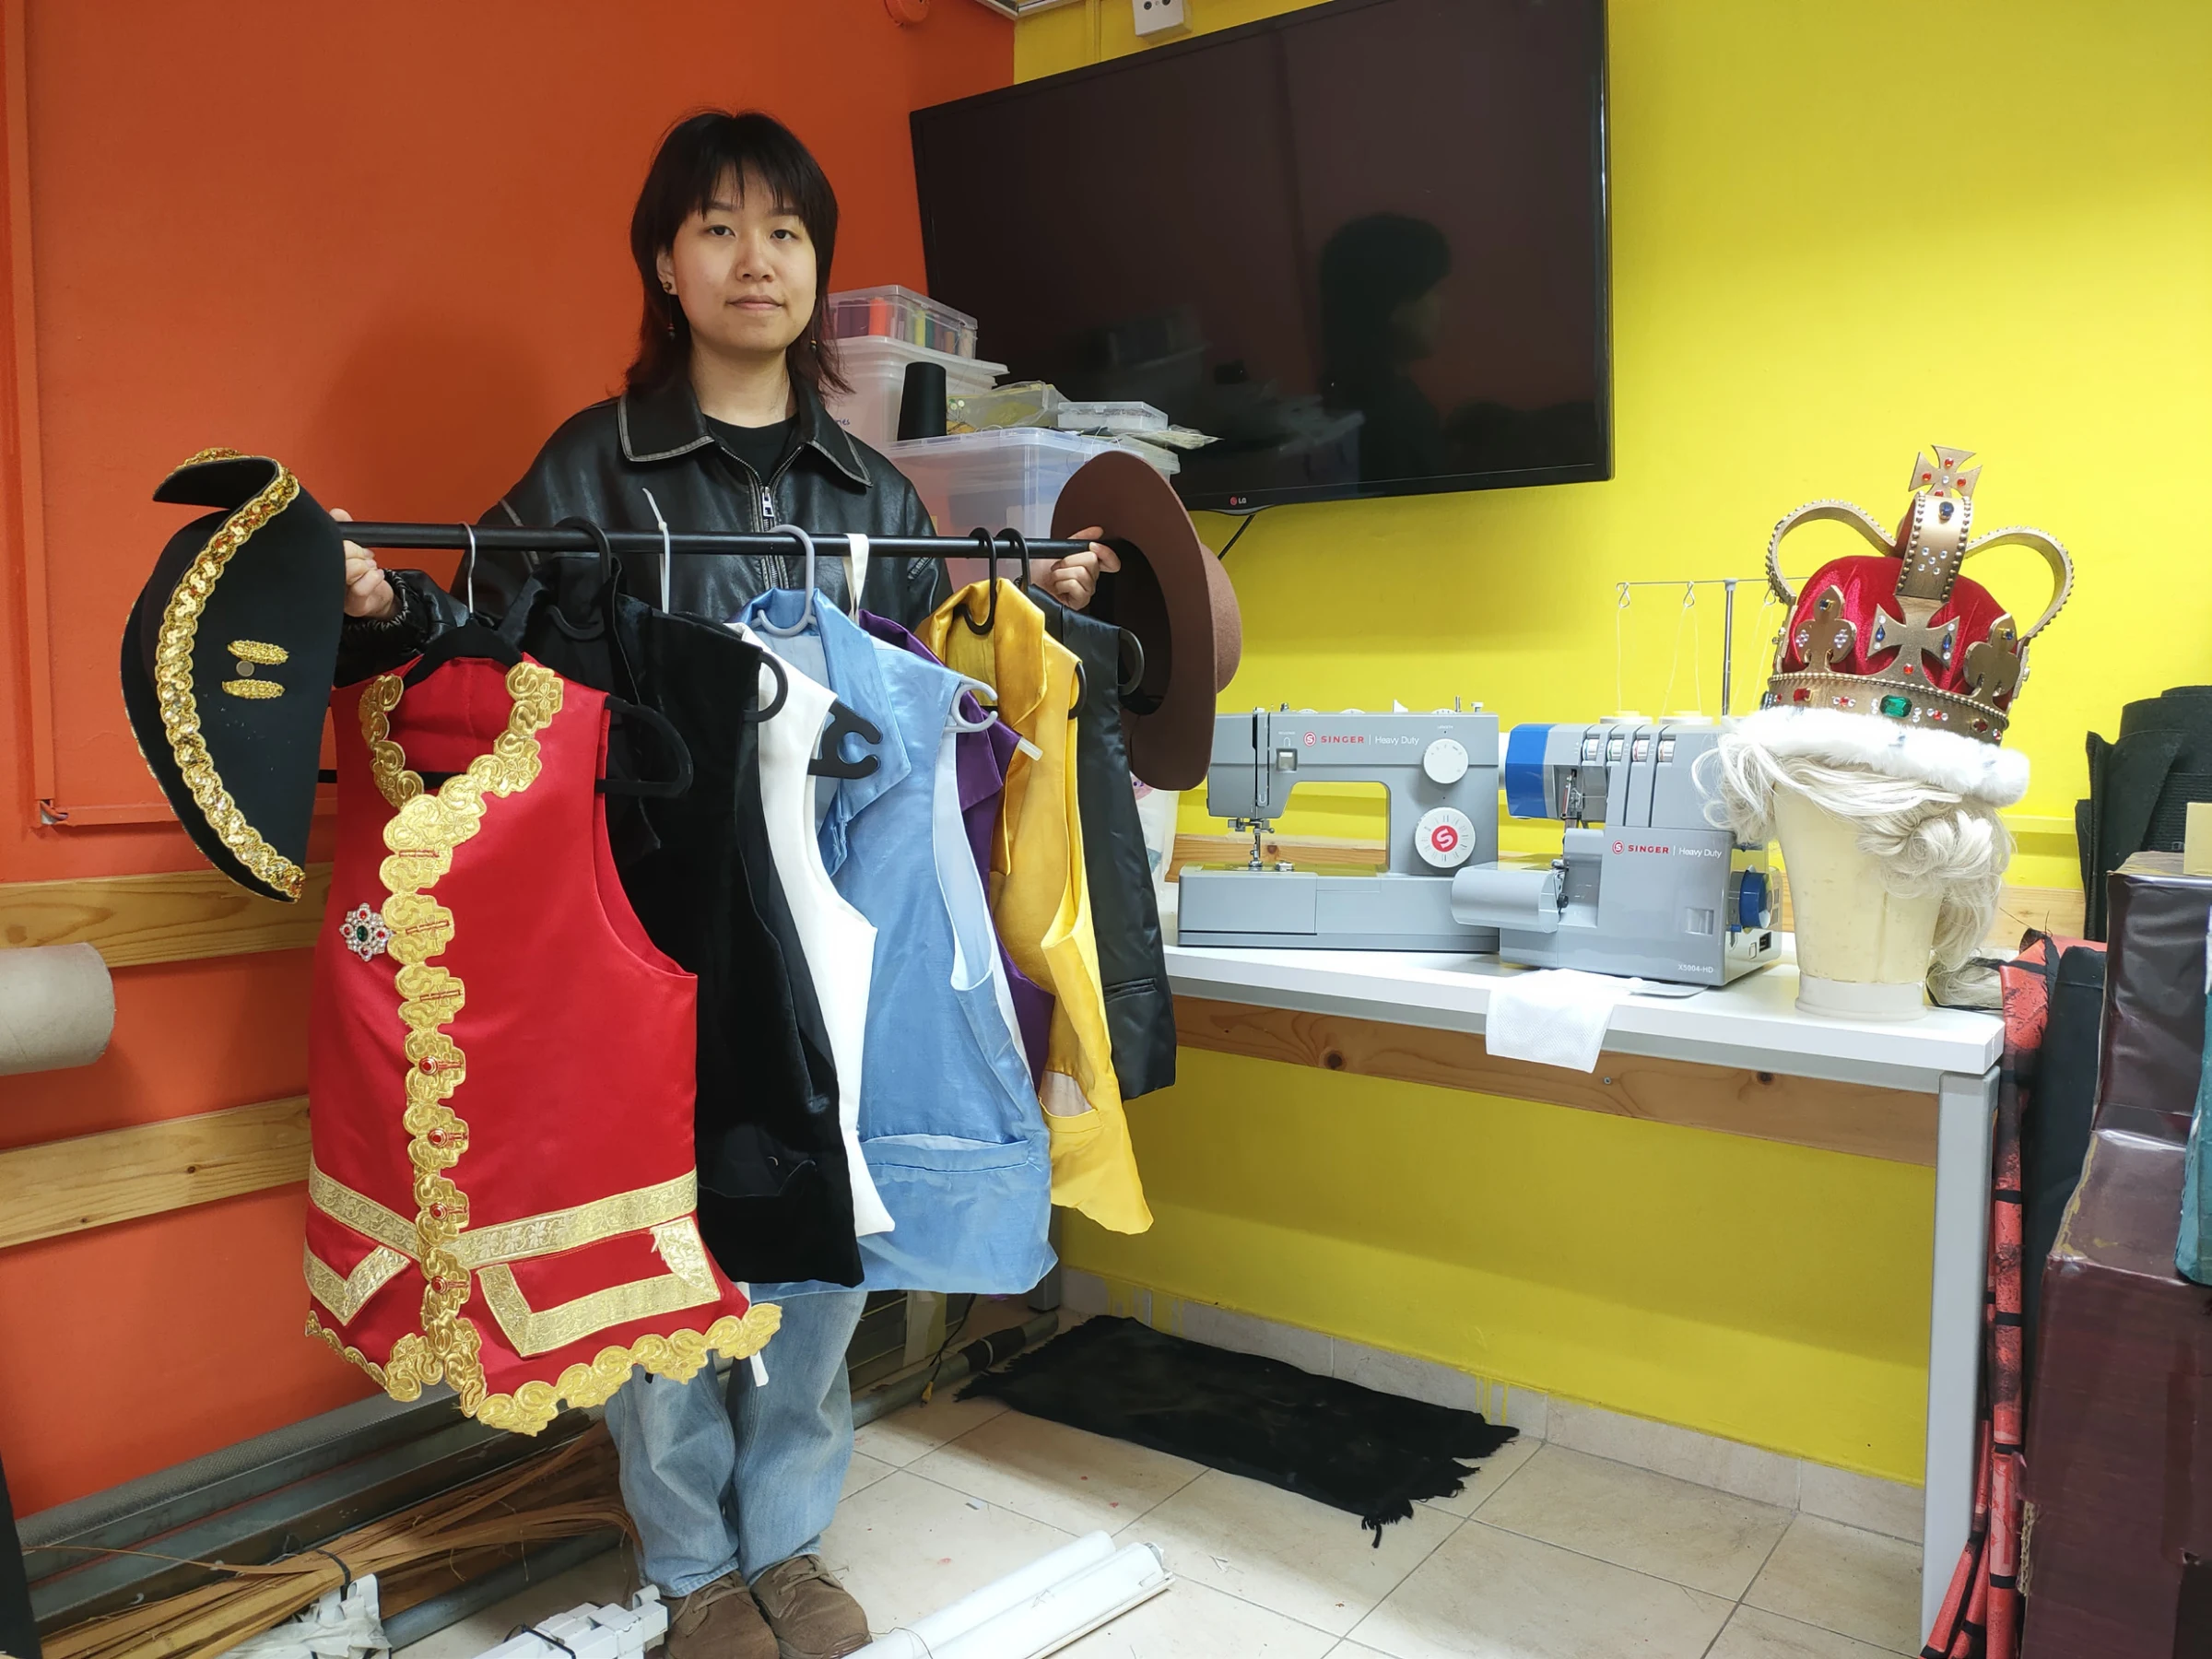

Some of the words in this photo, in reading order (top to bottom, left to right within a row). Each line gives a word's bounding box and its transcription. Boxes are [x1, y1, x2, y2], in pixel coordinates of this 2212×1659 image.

[1320, 735, 1365, 744] SINGER
[1374, 735, 1400, 746] Heavy
[1401, 735, 1419, 746] Duty
[1628, 844, 1669, 854] SINGER
[1678, 847, 1702, 857] Heavy
[1703, 849, 1722, 859] Duty
[1677, 964, 1713, 973] X5004-HD
